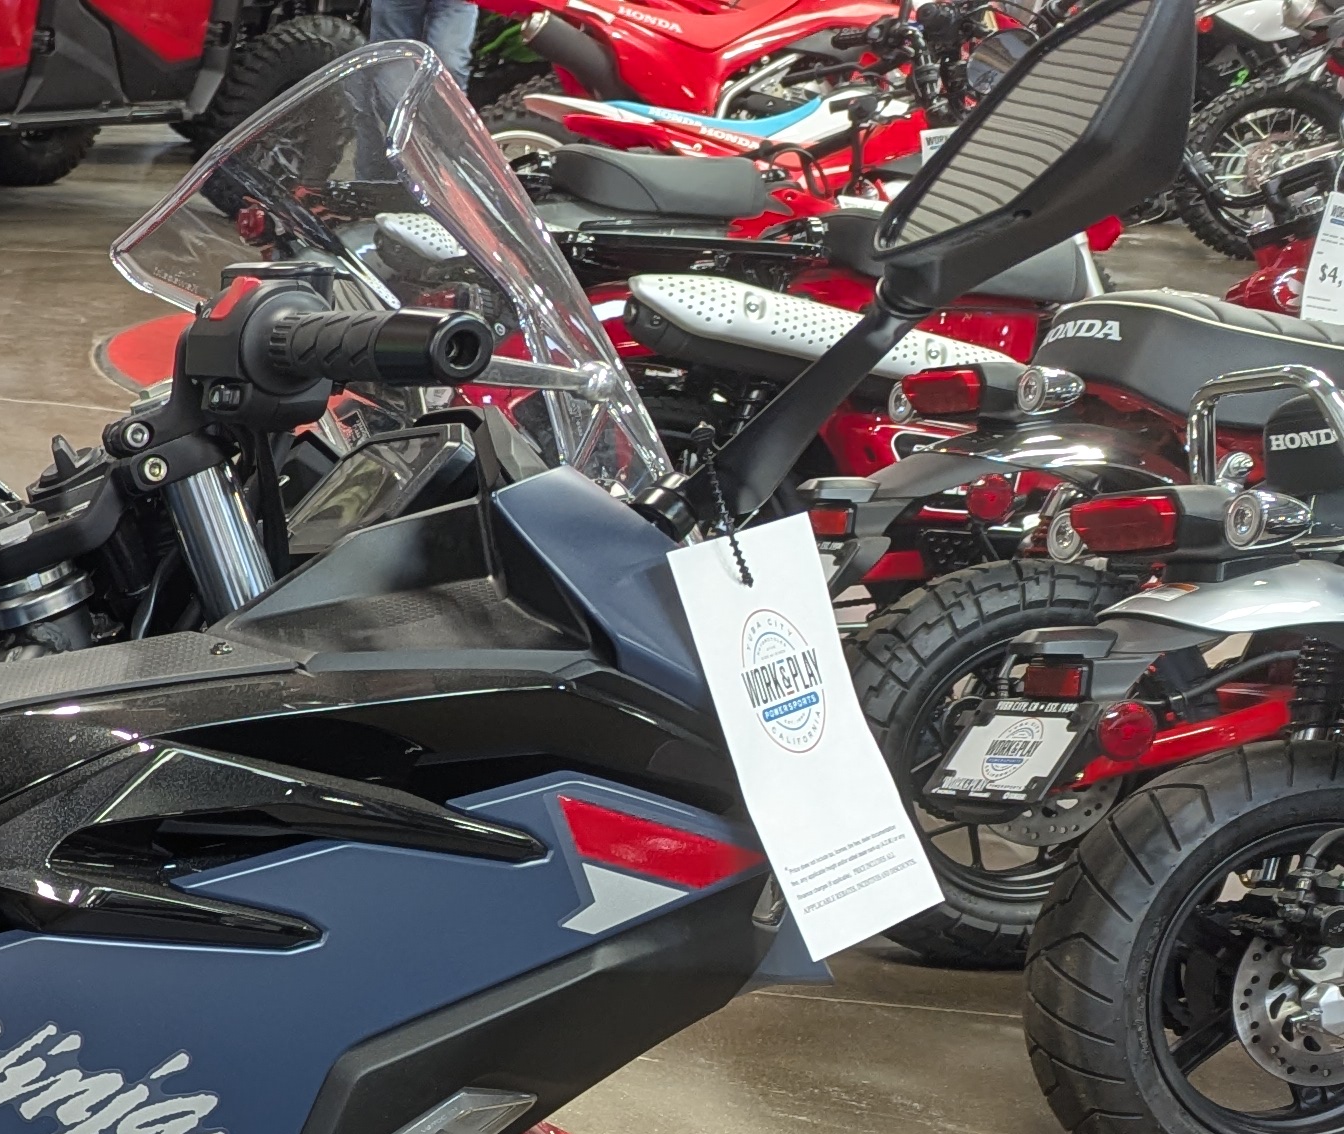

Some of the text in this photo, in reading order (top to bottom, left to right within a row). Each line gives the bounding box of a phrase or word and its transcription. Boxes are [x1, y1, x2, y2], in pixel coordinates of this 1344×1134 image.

[618, 6, 683, 33] HONDA
[699, 125, 760, 150] HONDA
[746, 618, 793, 651] YUBA CITY
[764, 694, 817, 719] POWERSPORTS
[771, 711, 822, 745] CALIFORNIA
